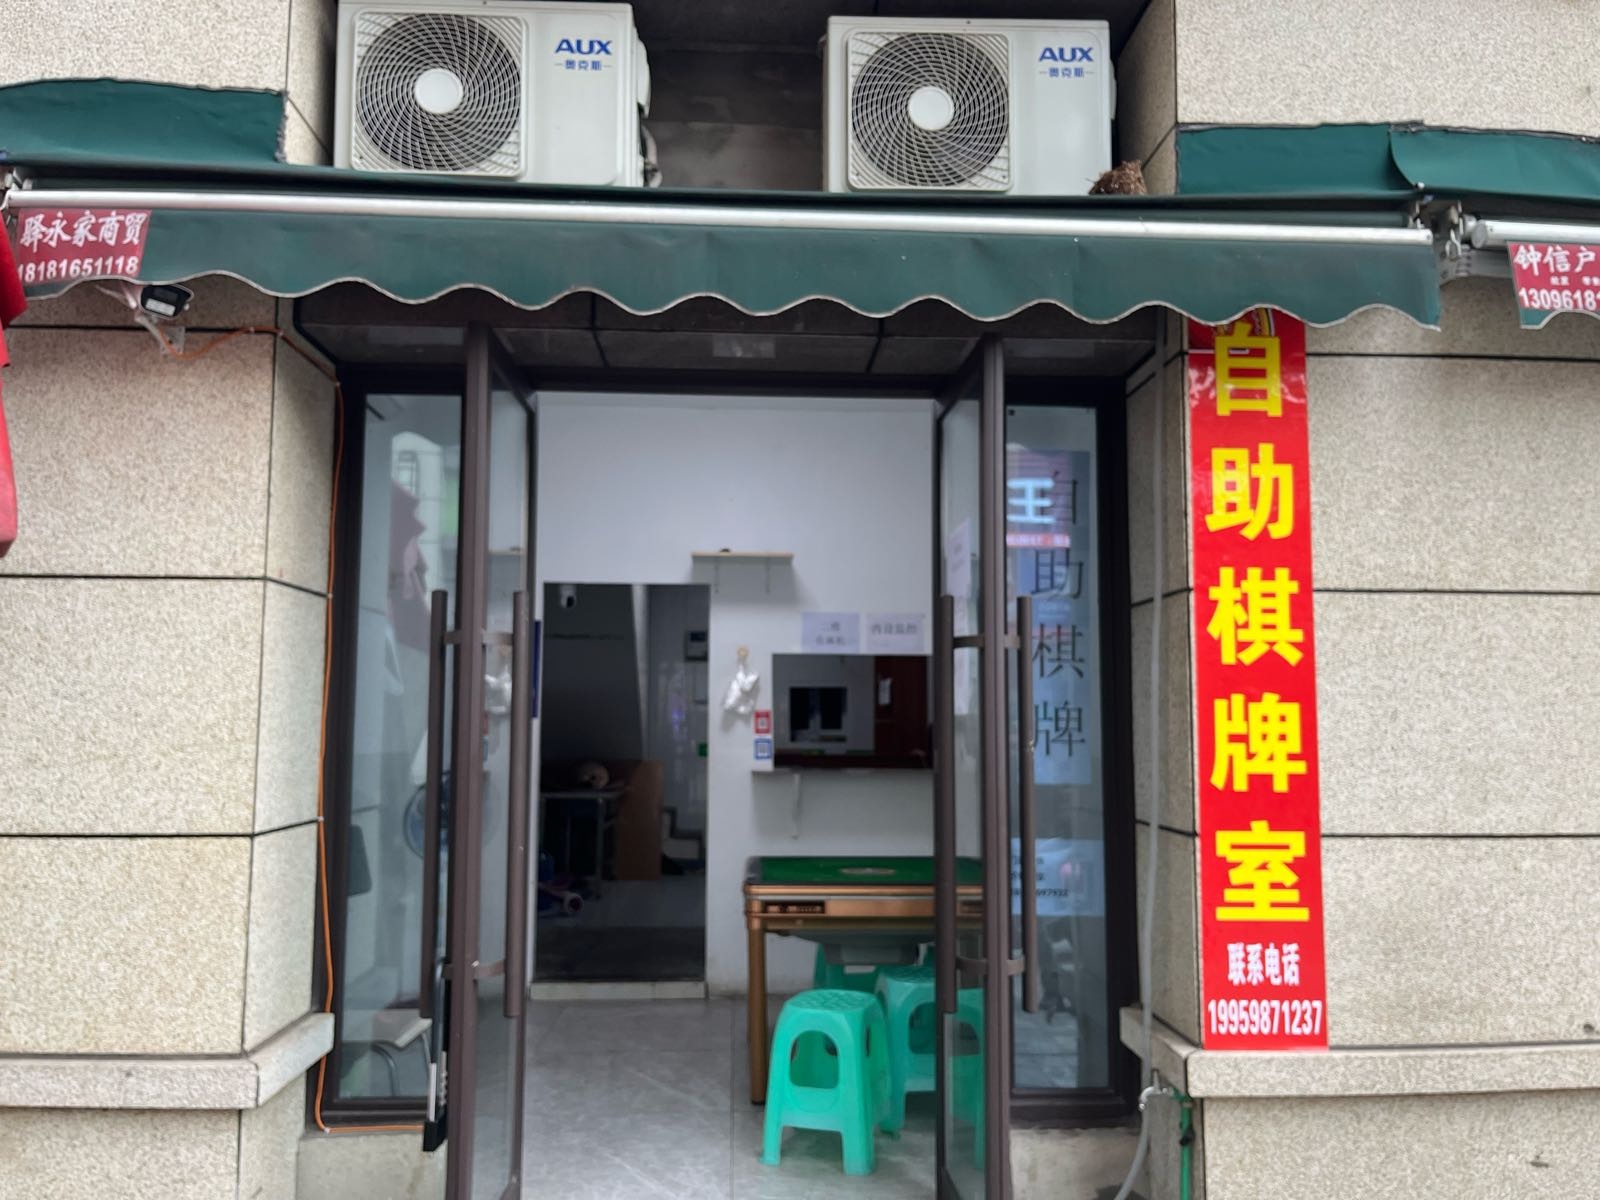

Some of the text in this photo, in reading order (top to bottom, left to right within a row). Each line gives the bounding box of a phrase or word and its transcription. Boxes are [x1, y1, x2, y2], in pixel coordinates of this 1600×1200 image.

[554, 38, 613, 56] AUX
[1039, 46, 1094, 63] AUX
[17, 255, 139, 283] 18181651118
[1206, 320, 1310, 922] 自助棋牌室
[1227, 942, 1300, 986] 联系电话
[1208, 999, 1323, 1035] 19959871237
